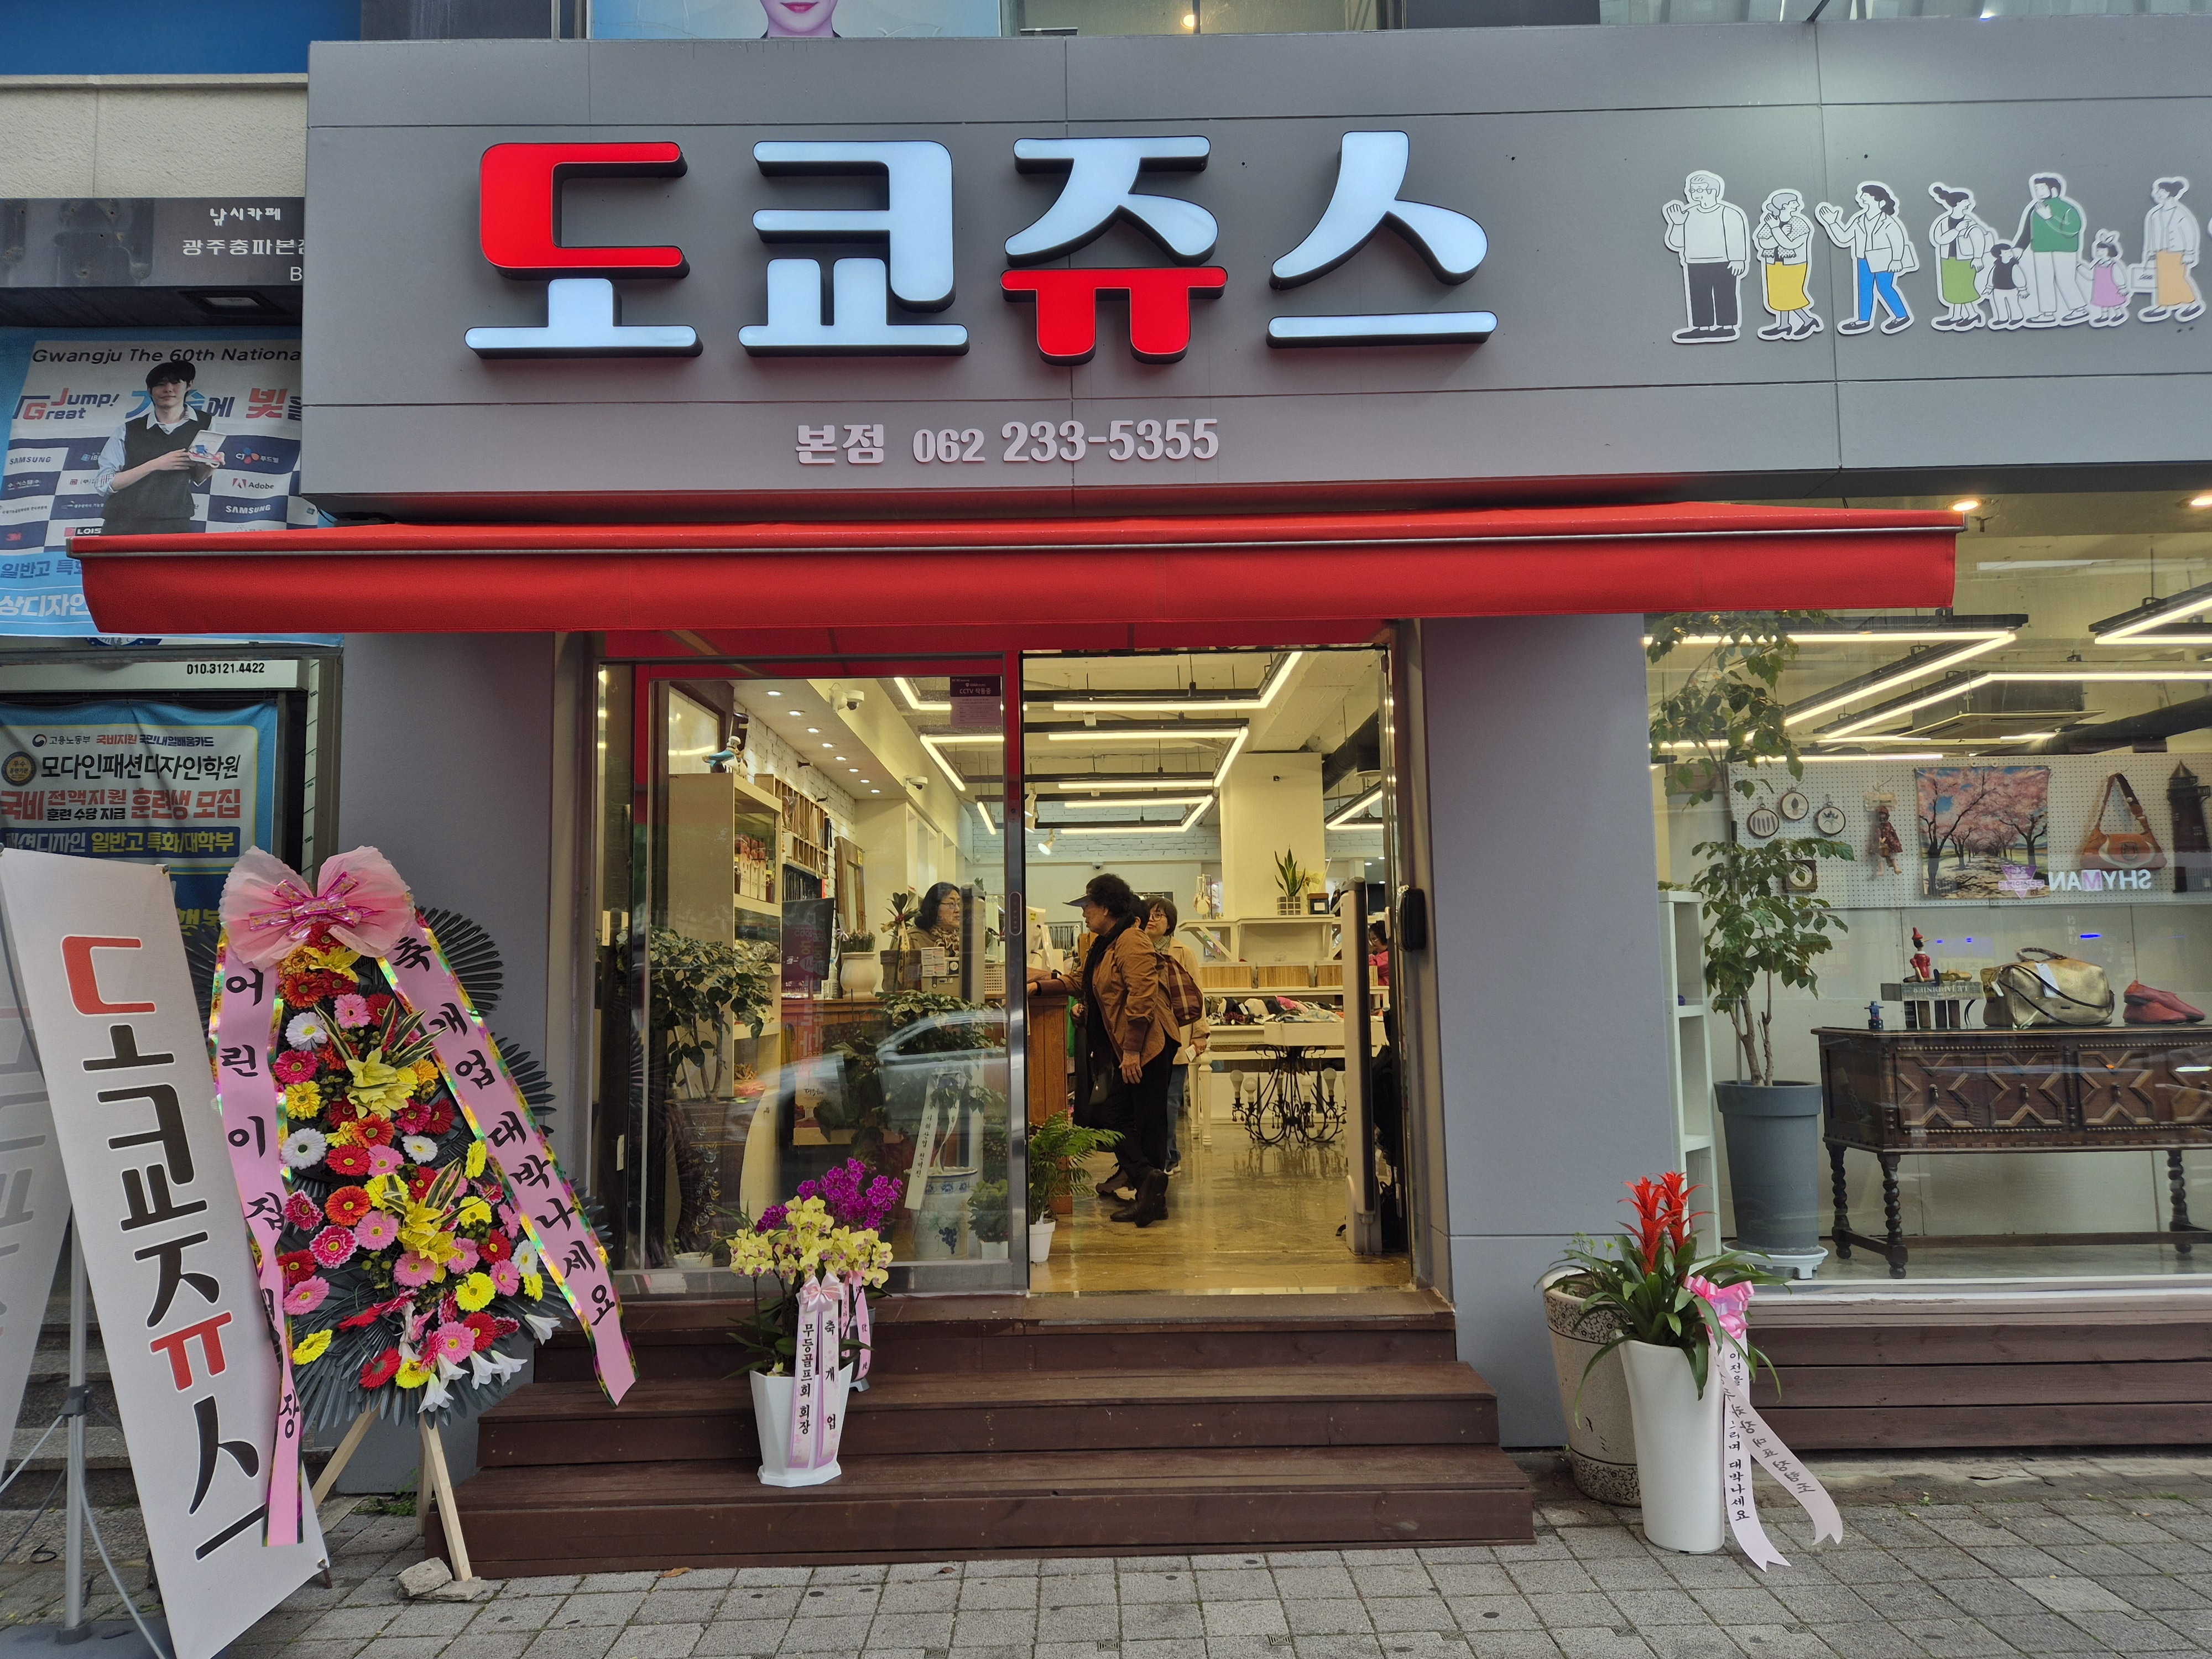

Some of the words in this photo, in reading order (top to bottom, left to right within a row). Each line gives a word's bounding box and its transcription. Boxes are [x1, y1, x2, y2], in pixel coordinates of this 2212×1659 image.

[210, 207, 281, 226] 낚시카페
[464, 131, 1499, 366] 도쿄쥬스
[32, 348, 122, 364] Gwangju
[129, 348, 163, 361] The
[169, 348, 215, 361] 60th
[51, 388, 120, 408] Jump!
[23, 403, 86, 420] Great
[797, 423, 885, 465] 본점
[912, 427, 985, 464] 062
[1000, 417, 1220, 463] 233-5355
[9, 456, 51, 465] SAMSUNG
[225, 504, 272, 514] SAMSUNG
[6, 533, 23, 541] 3M
[1, 560, 50, 579] 일반고
[186, 662, 265, 675] 010.3121.4422
[49, 735, 91, 745] 고용노동부
[96, 734, 137, 745] 국비지원
[139, 734, 215, 747] 국민내일배움카드
[41, 753, 241, 781] 모다인패션디자인학원
[1, 790, 45, 821] 국비
[48, 789, 127, 806] 전액지원
[131, 787, 192, 820] 훈련생
[194, 789, 241, 818] 모집
[47, 807, 72, 821] 훈련
[74, 807, 98, 821] 수당
[100, 807, 126, 820] 지급
[91, 832, 144, 853] 일반고
[147, 831, 234, 853] 특화/대학부
[221, 968, 285, 1232] 어린이집
[487, 1110, 616, 1327] 대박나세요
[800, 1323, 815, 1398] 무등골프회
[799, 1404, 811, 1435] 회장
[1728, 1458, 1751, 1522] 대박나세요
